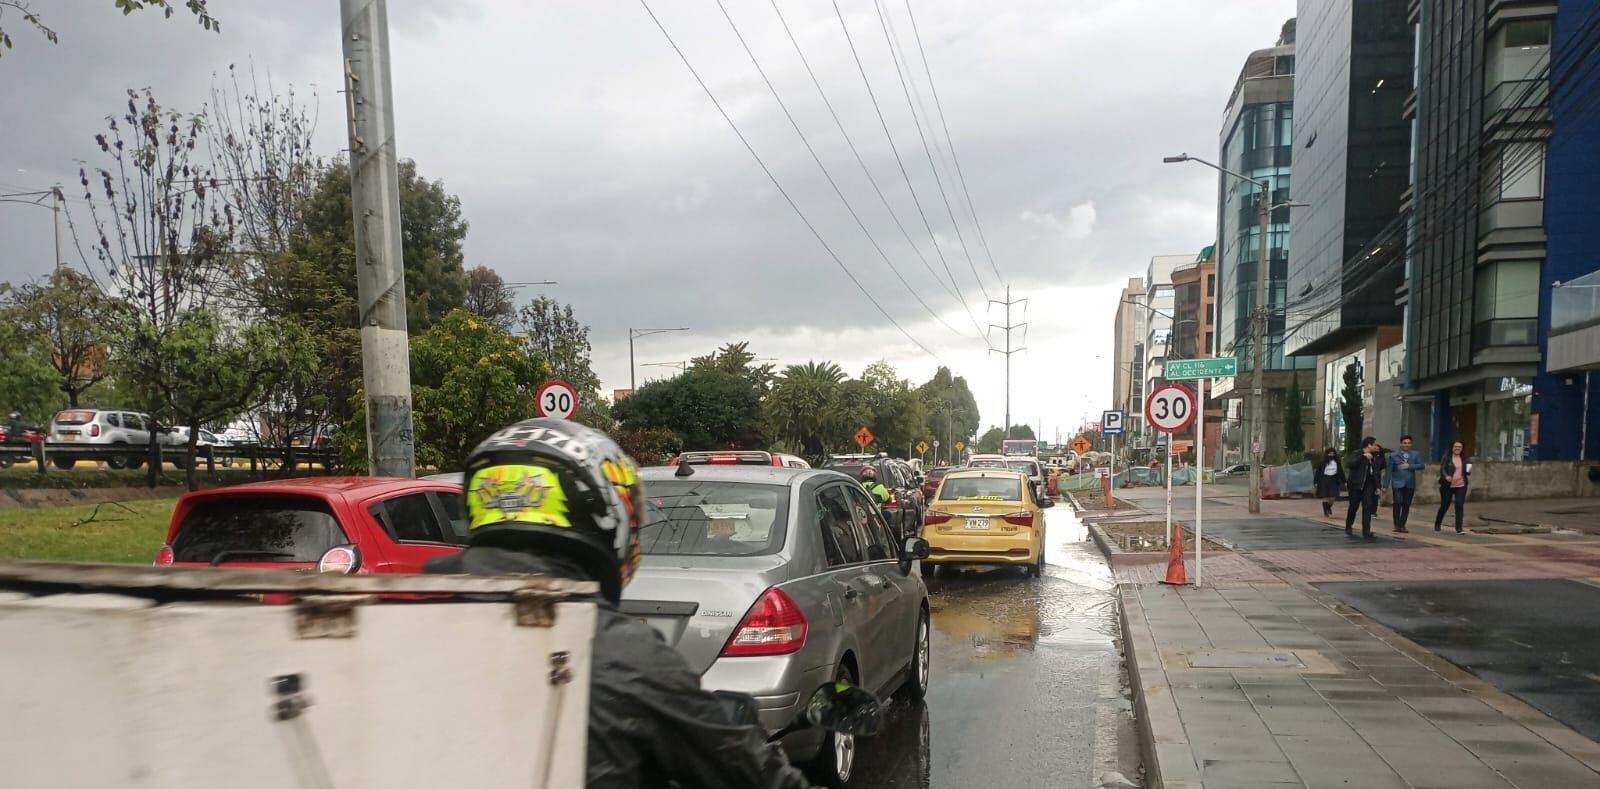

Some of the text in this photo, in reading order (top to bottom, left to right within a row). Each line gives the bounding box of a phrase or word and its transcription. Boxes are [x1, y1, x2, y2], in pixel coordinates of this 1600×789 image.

[1194, 361, 1205, 369] 116
[1182, 368, 1224, 377] OCCIDENTE
[544, 392, 570, 413] 30
[1155, 396, 1187, 420] 30
[1106, 413, 1120, 427] P
